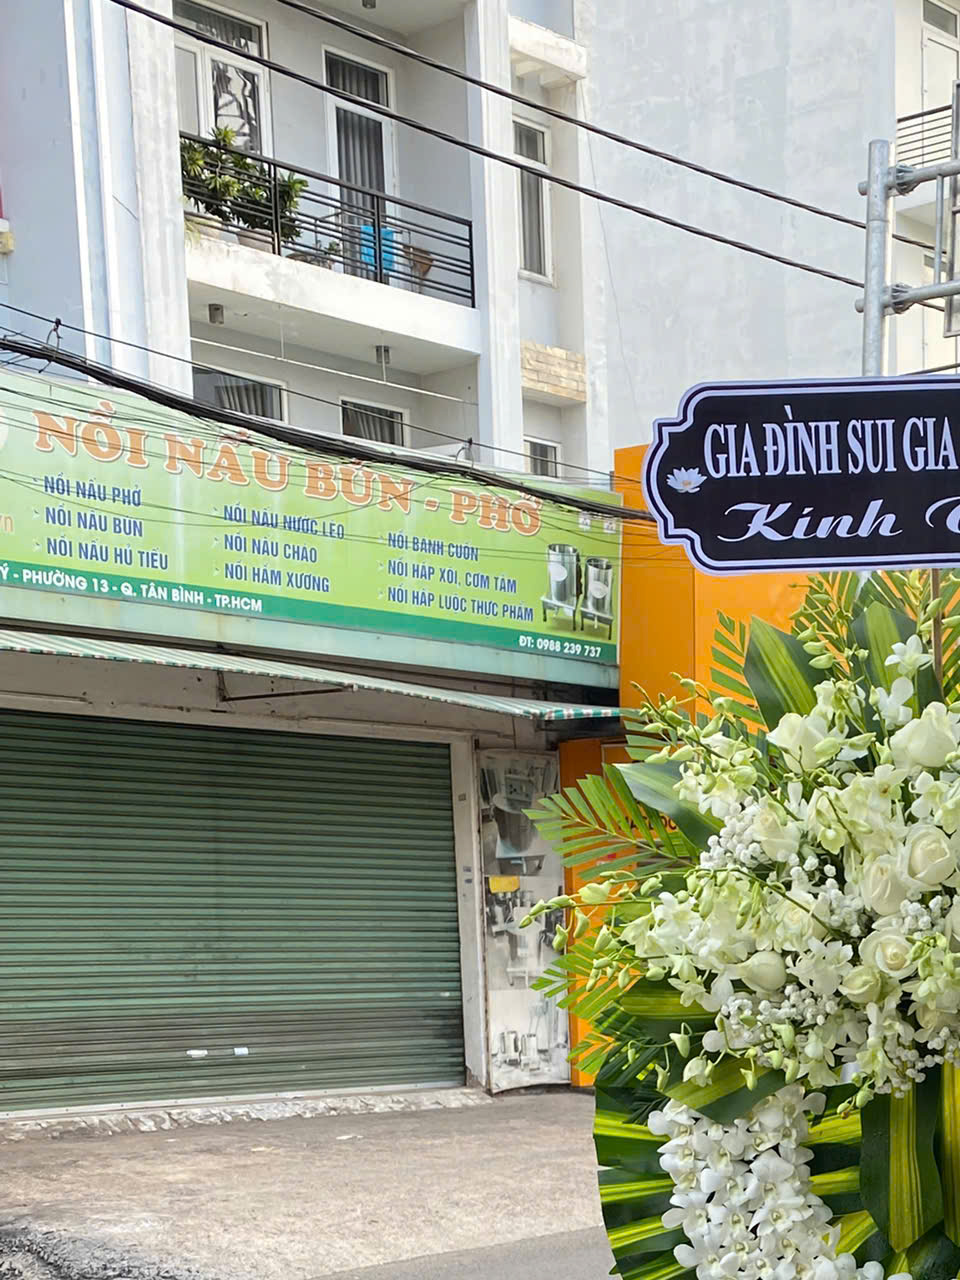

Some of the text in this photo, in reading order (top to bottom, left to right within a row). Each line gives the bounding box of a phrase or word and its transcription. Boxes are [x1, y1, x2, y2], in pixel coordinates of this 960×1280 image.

[32, 400, 149, 467] NỒI
[163, 430, 292, 491] NẤU
[704, 422, 761, 478] GIA
[762, 405, 840, 476] ĐÌNH
[847, 419, 897, 475] SUI
[903, 416, 959, 471] GIA
[717, 499, 902, 542] Kính
[23, 569, 87, 590] PHƯỜNG
[92, 578, 109, 592] 13
[120, 582, 136, 596] Q.
[140, 580, 167, 600] TÂN
[172, 585, 204, 604] BÌNH
[214, 594, 262, 612] TP.HCM
[536, 638, 561, 652] 0988
[563, 642, 581, 655] 239
[583, 645, 601, 657] 737
